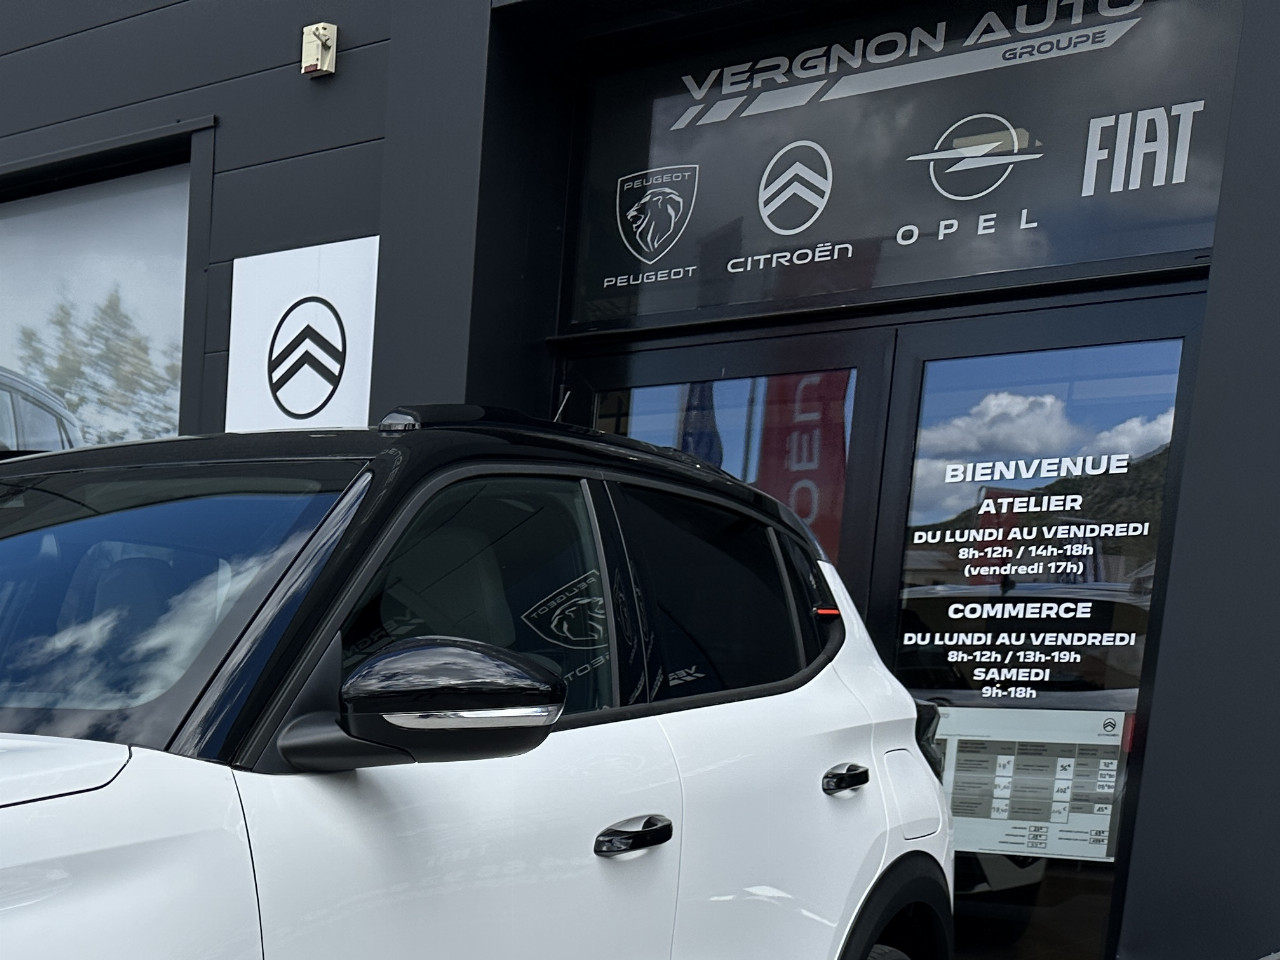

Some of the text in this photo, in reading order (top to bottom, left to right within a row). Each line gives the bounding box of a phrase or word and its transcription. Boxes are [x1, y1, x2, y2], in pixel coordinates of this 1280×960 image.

[1001, 29, 1108, 62] GROUPE
[681, 21, 947, 100] VERGNON
[1081, 100, 1205, 198] FIAT
[623, 172, 692, 191] PEUGEOT
[896, 208, 1038, 246] OPEL
[726, 242, 853, 274] CITROËN
[603, 265, 698, 289] PEUGEOT
[944, 453, 1130, 483] BIENVENUE
[977, 494, 1083, 515] ATELIER
[913, 522, 1149, 544] DU LUNDI AU VENDREDI
[958, 544, 1094, 560] 8h-12h / 14h-18h
[964, 560, 1084, 577] (vendredi 17h)
[947, 602, 1093, 620] COMMERCE
[903, 632, 1136, 646] DU LUNDI AU VENDREDI
[947, 650, 1081, 663] 8h-12h / 13h-19h
[972, 667, 1051, 682] SAMEDI
[981, 684, 1037, 699] 9h-18h
